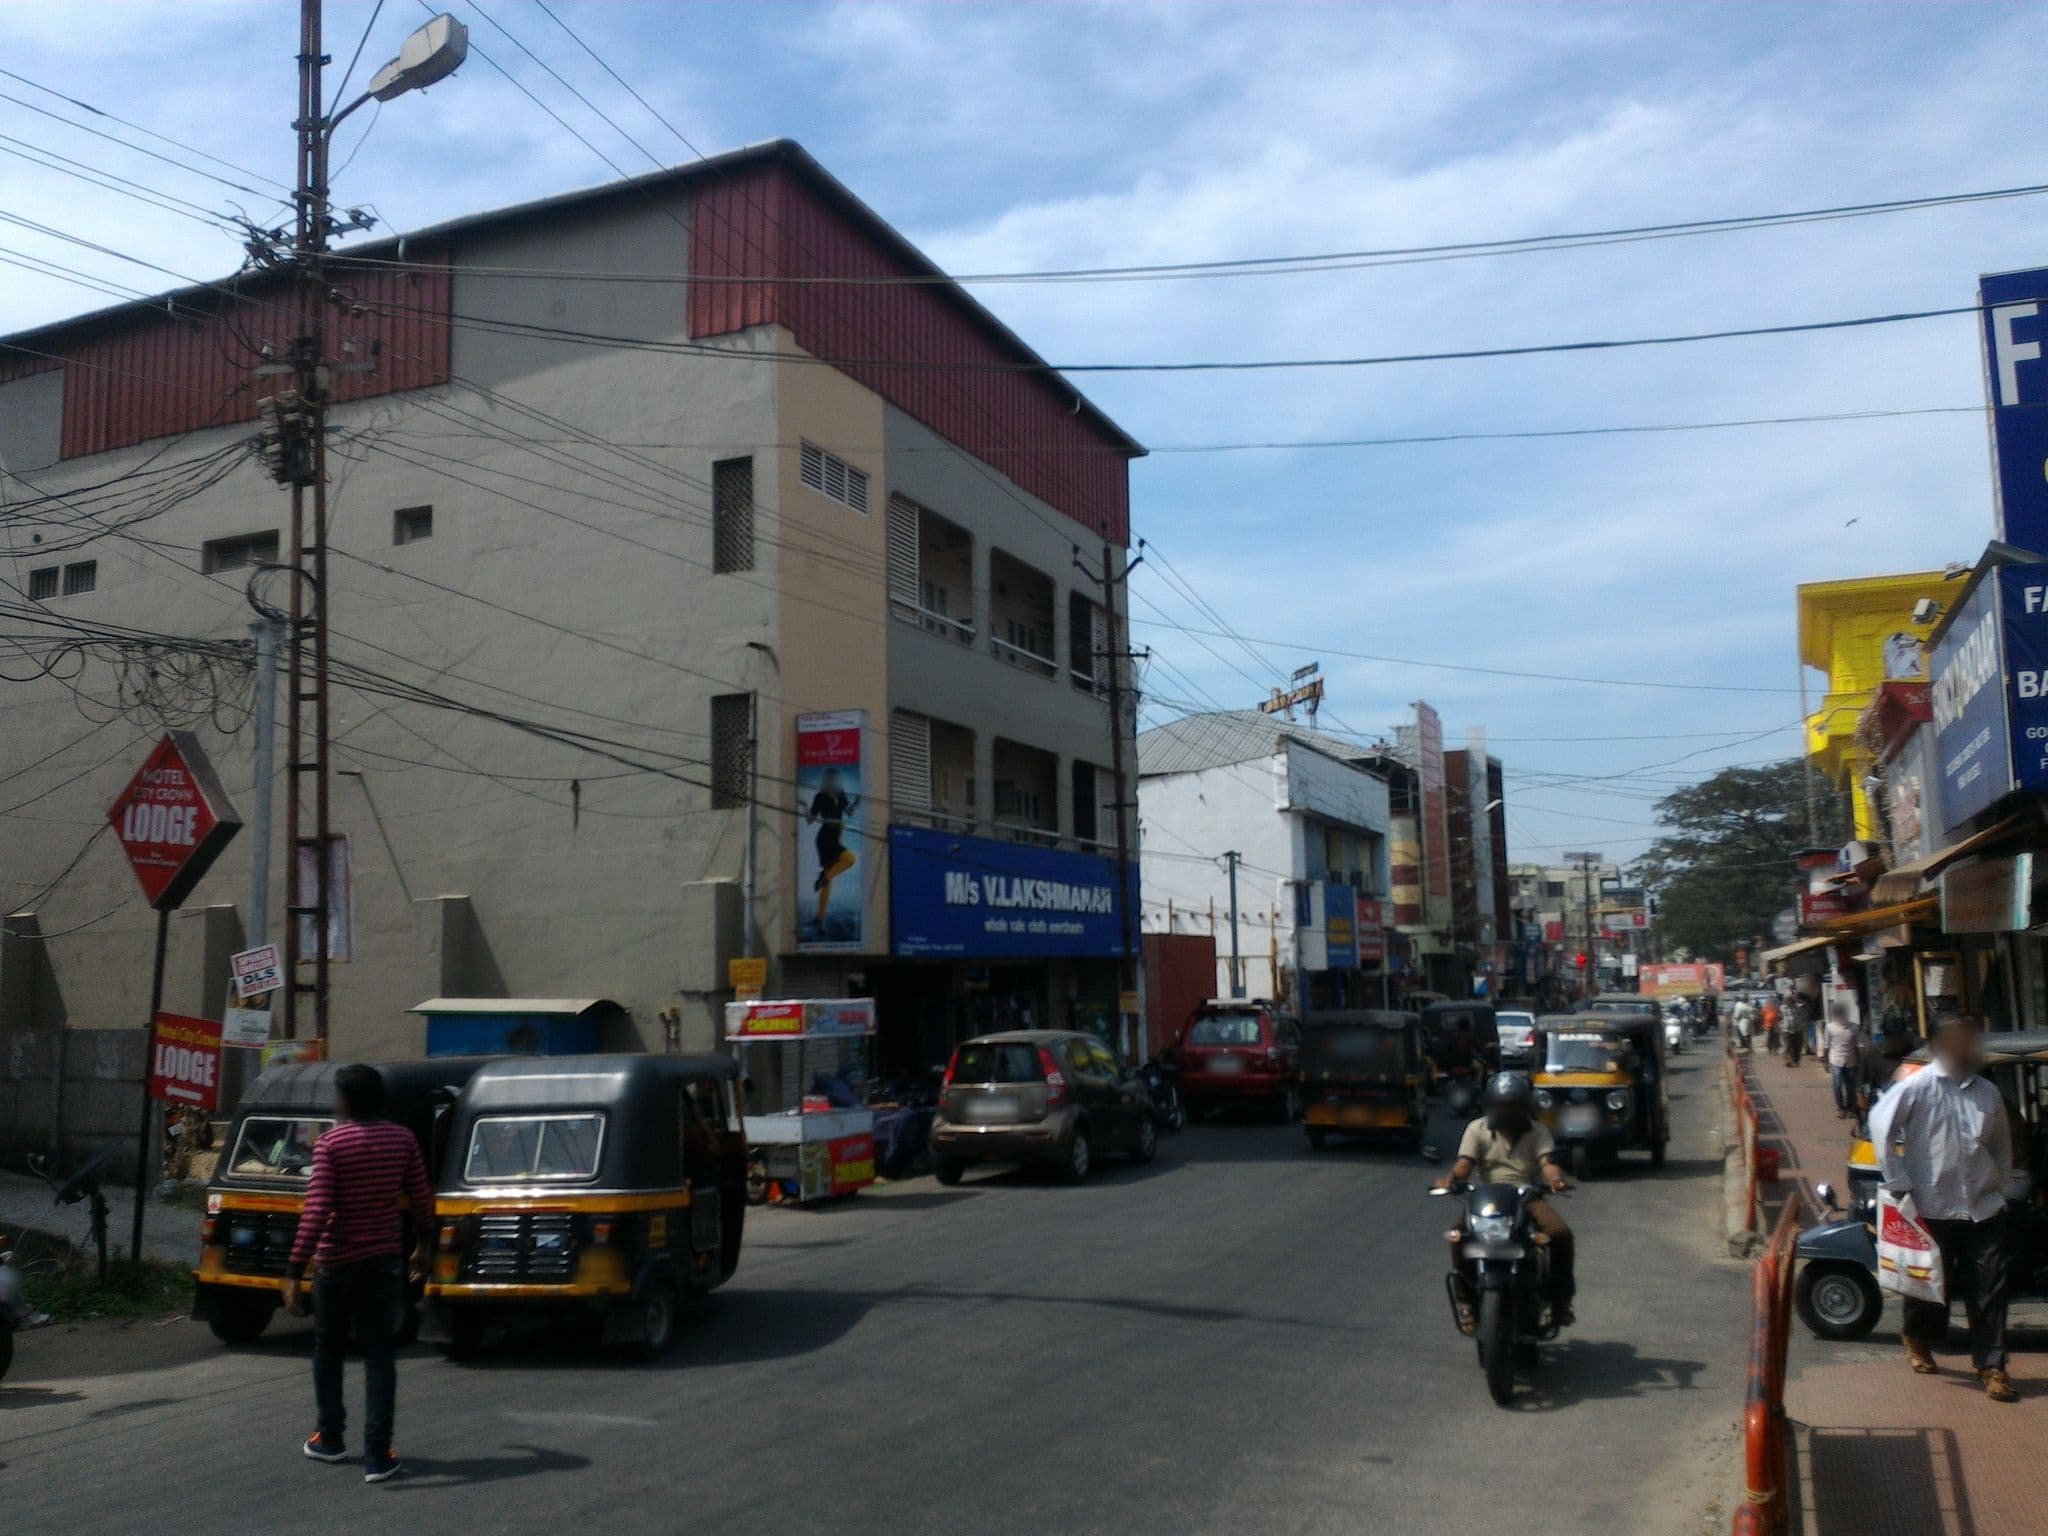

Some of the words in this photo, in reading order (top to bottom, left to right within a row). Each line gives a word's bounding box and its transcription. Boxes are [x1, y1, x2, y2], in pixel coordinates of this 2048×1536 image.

[123, 803, 198, 846] LODGE
[243, 968, 275, 985] DLS
[154, 1043, 216, 1087] LODGE
